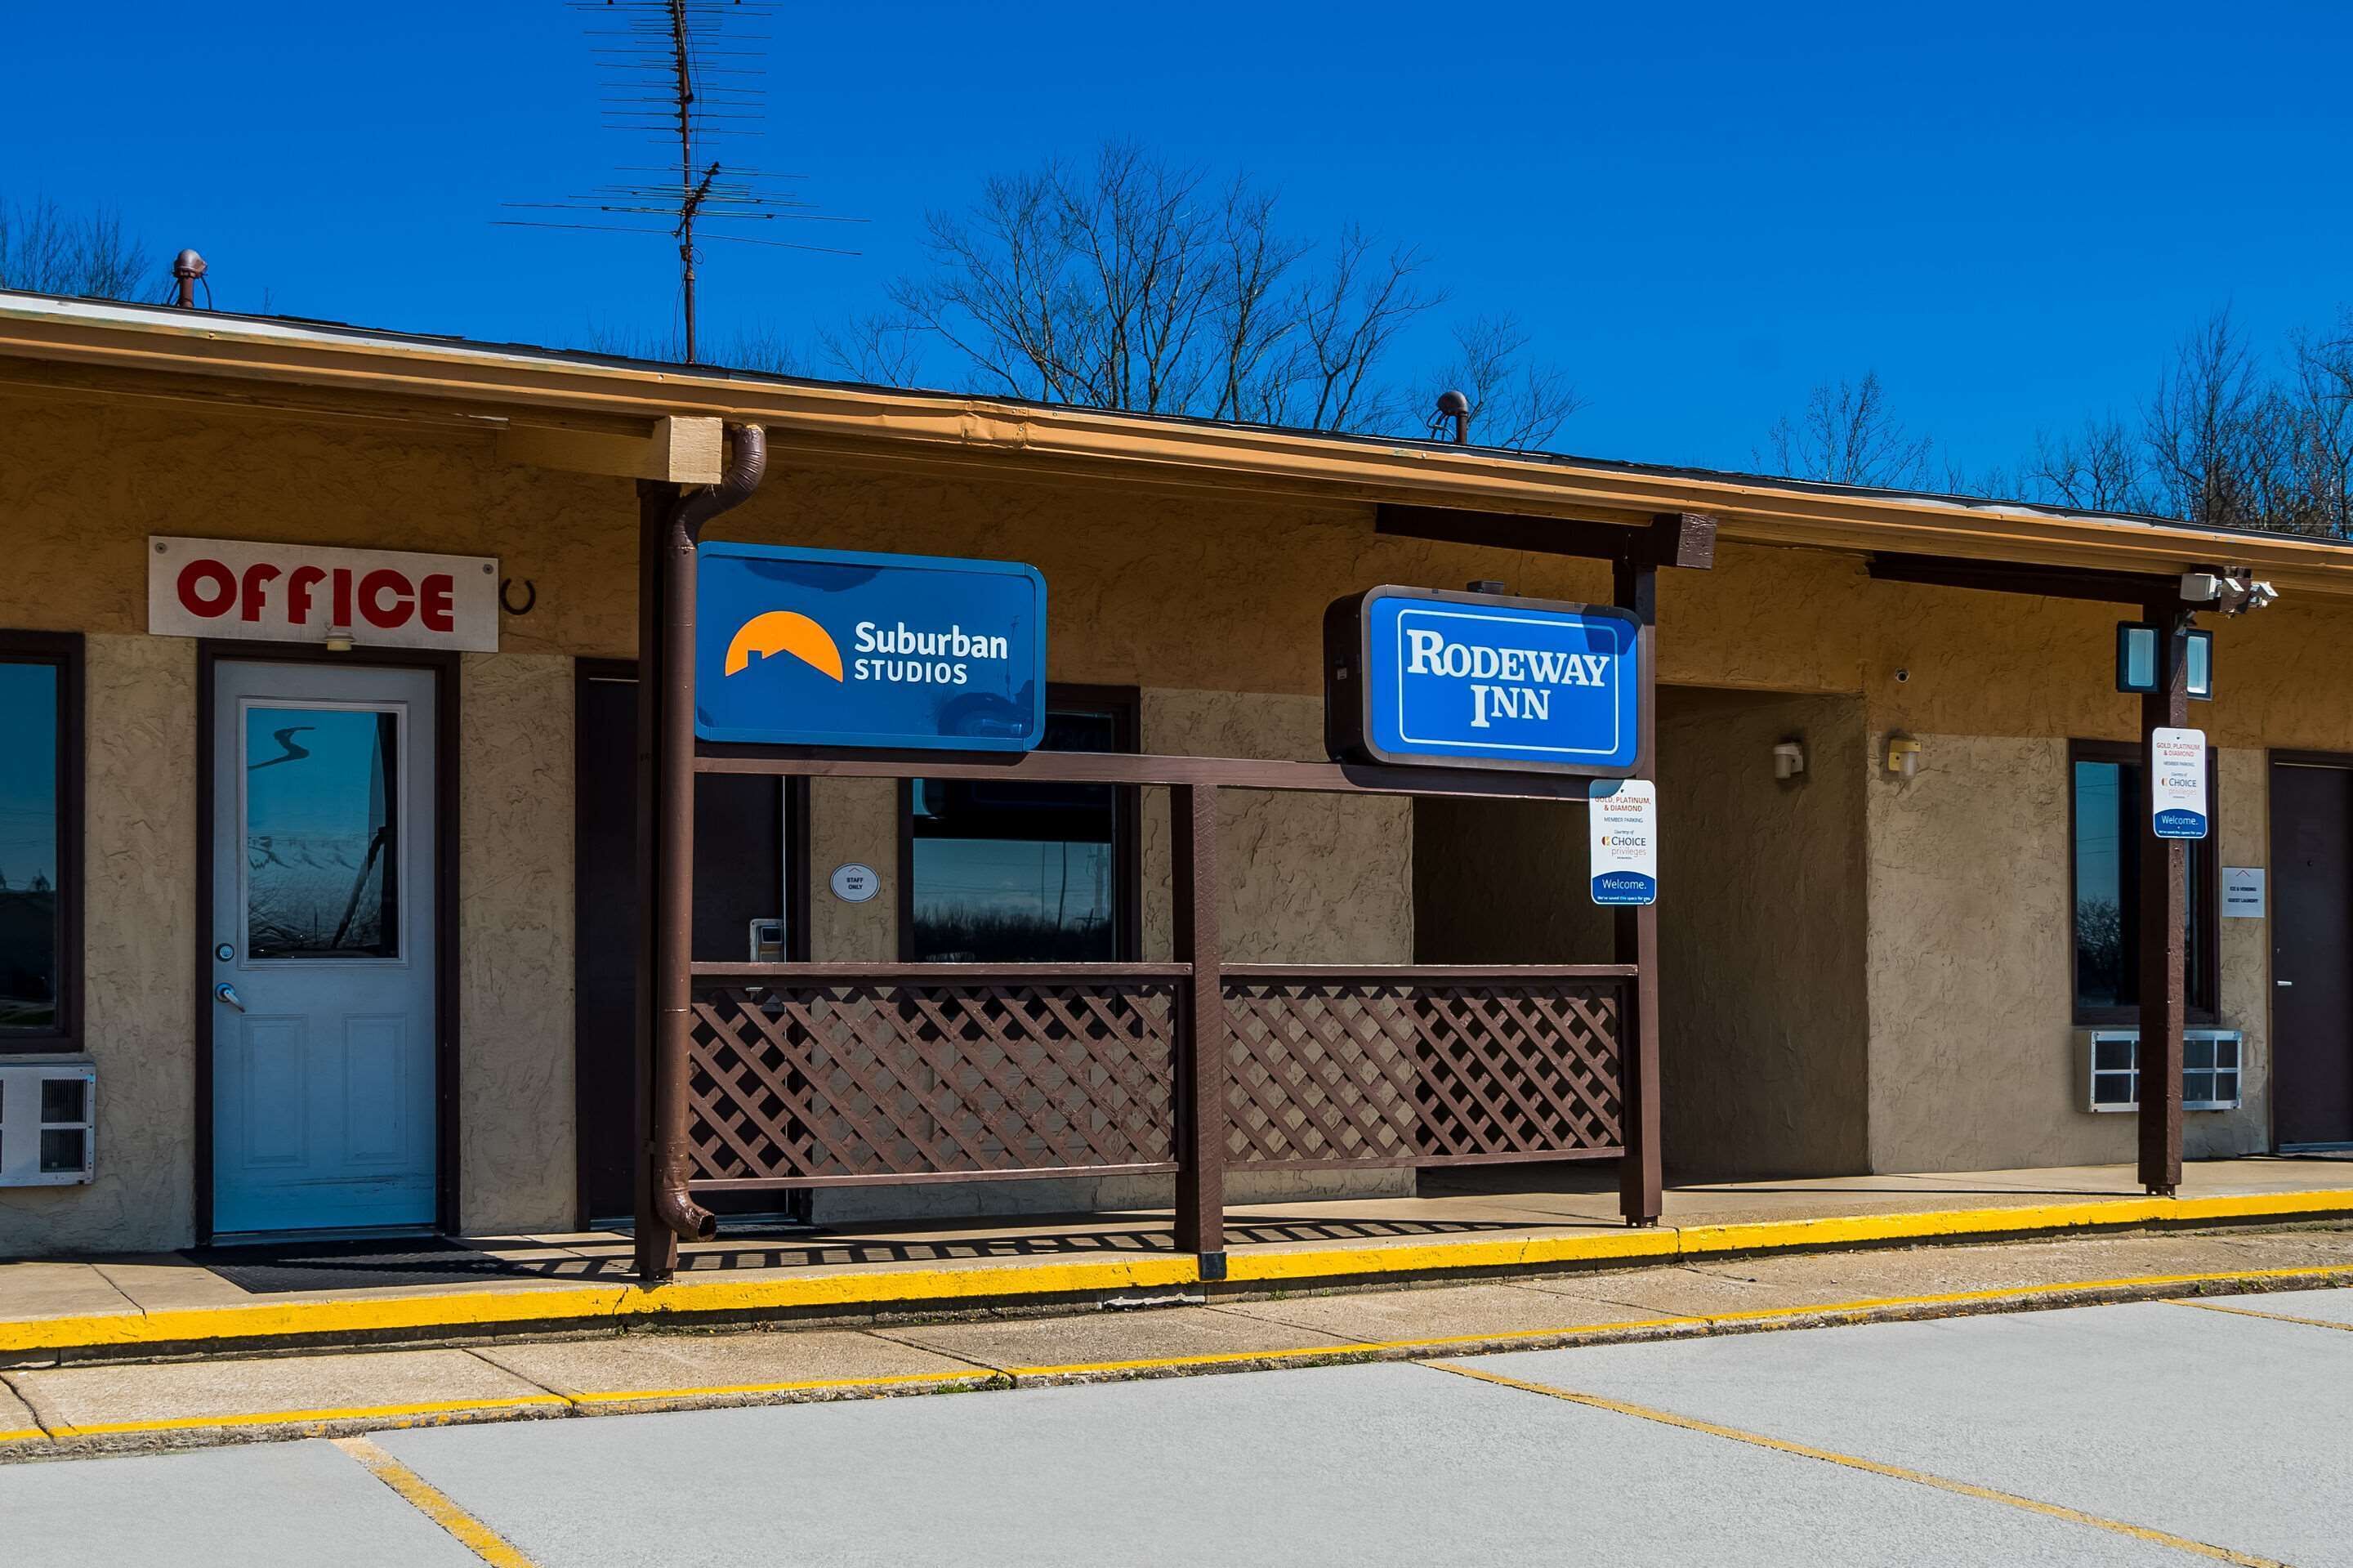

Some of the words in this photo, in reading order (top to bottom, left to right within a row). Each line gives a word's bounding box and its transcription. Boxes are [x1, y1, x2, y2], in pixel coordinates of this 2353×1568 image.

[176, 558, 453, 632] OFFICE
[854, 621, 1007, 659] Suburban
[1406, 628, 1610, 687] RODEWAY
[854, 659, 967, 685] STUDIOS
[1470, 684, 1552, 728] INN
[2169, 778, 2196, 788] CHOICE
[1611, 836, 1646, 847] CHOICE
[1611, 847, 1647, 858] privileges
[1601, 878, 1647, 890] Welcome.
